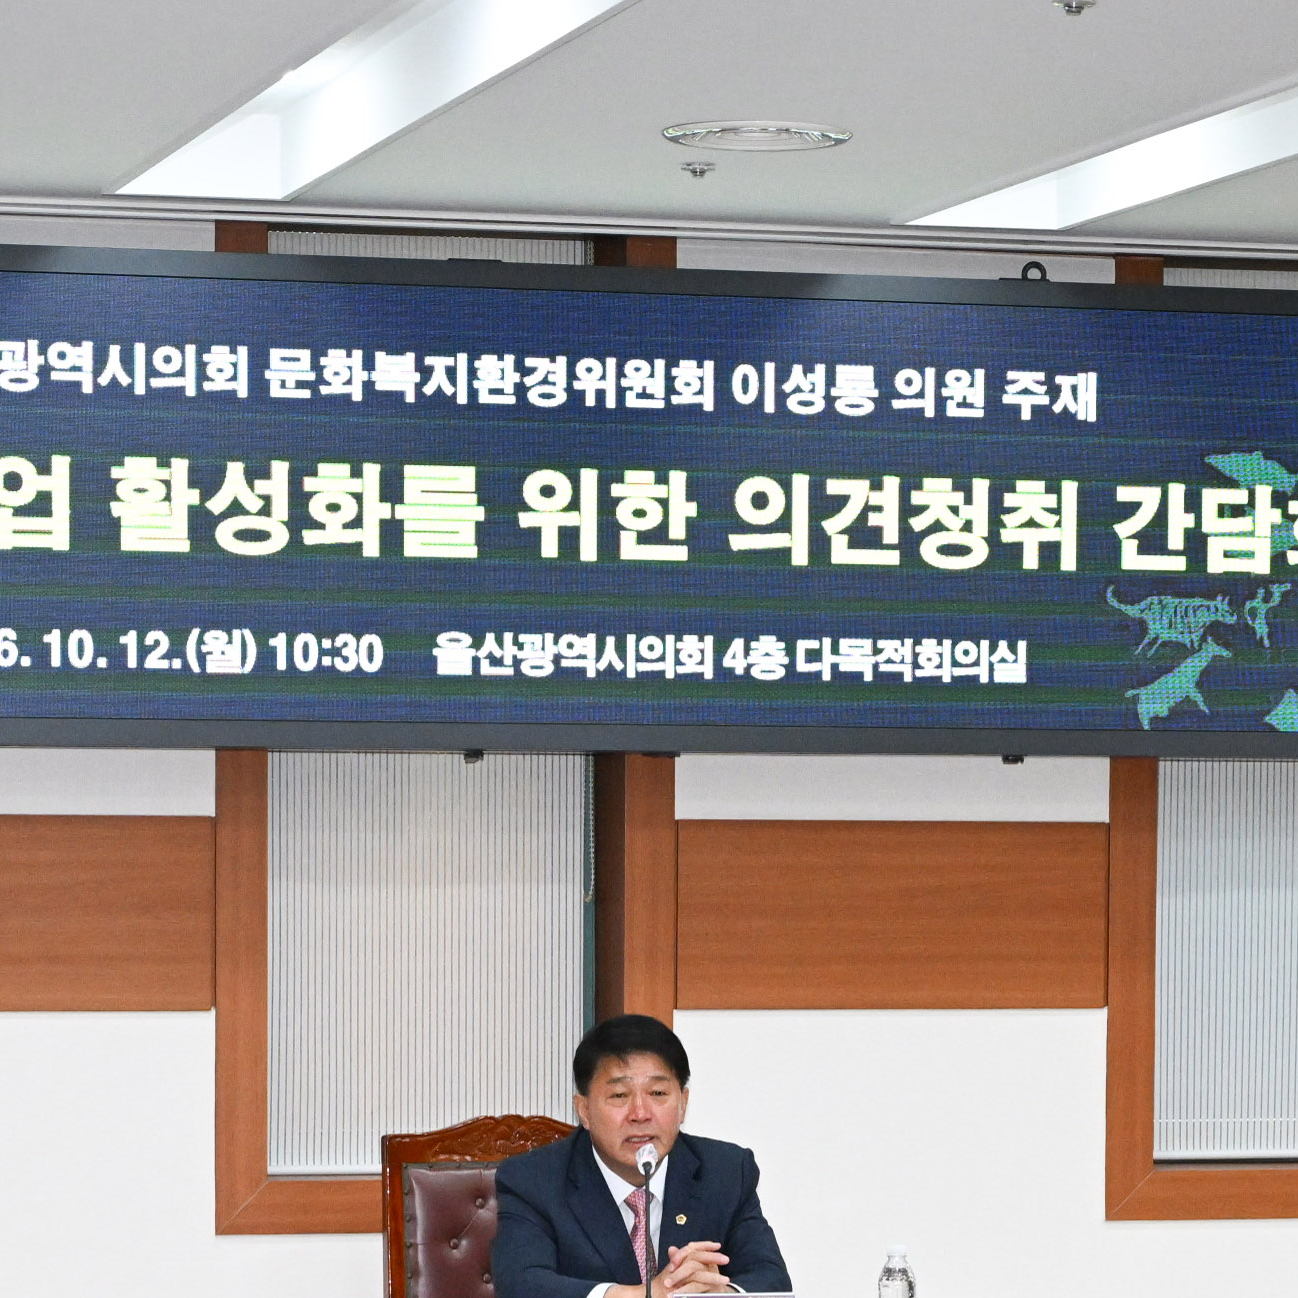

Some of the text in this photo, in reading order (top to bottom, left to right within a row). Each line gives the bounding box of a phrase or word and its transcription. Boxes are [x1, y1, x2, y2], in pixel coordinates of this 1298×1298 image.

[264, 346, 715, 412] 문화복지환경위원회
[731, 361, 879, 417] 이성룡
[891, 366, 986, 418] 의원
[1002, 370, 1098, 423] 주재
[109, 456, 485, 558] 활성화를
[517, 467, 698, 562] 위한
[728, 473, 1079, 571] 의견청취
[42, 628, 108, 669] 10.
[119, 627, 257, 675] 12.(월)
[269, 631, 385, 673] 10:30
[432, 630, 1027, 684] 울산광역시의회 4층 다목적회의실
